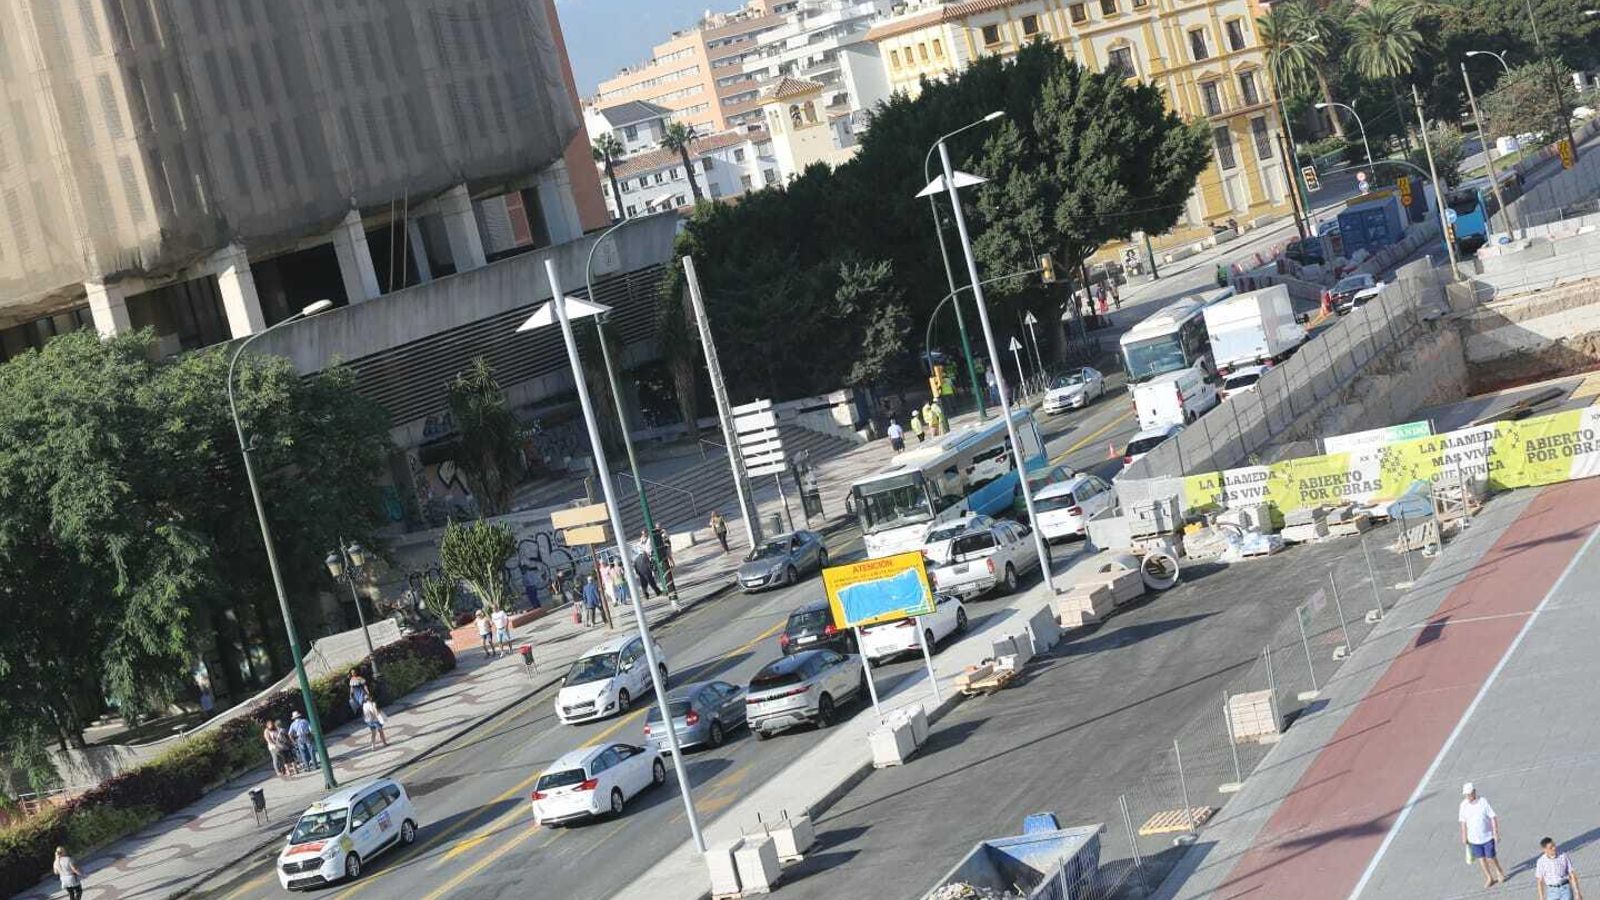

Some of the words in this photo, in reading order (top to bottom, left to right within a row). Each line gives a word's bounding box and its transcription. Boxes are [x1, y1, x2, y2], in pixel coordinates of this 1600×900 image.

[1419, 442, 1437, 454] LA
[1440, 428, 1503, 450] ALAMEDA
[1526, 428, 1594, 452] ABIERTO
[1464, 445, 1497, 461] VIVA
[1527, 448, 1559, 464] POR
[1460, 459, 1505, 478] NUNCA
[1198, 479, 1215, 491] LA
[1218, 470, 1277, 488] ALAMEDA
[1299, 469, 1362, 490] ABIERTO
[1240, 484, 1271, 499] VIVA
[1300, 487, 1330, 502] POR
[1332, 479, 1383, 498] OBRAS
